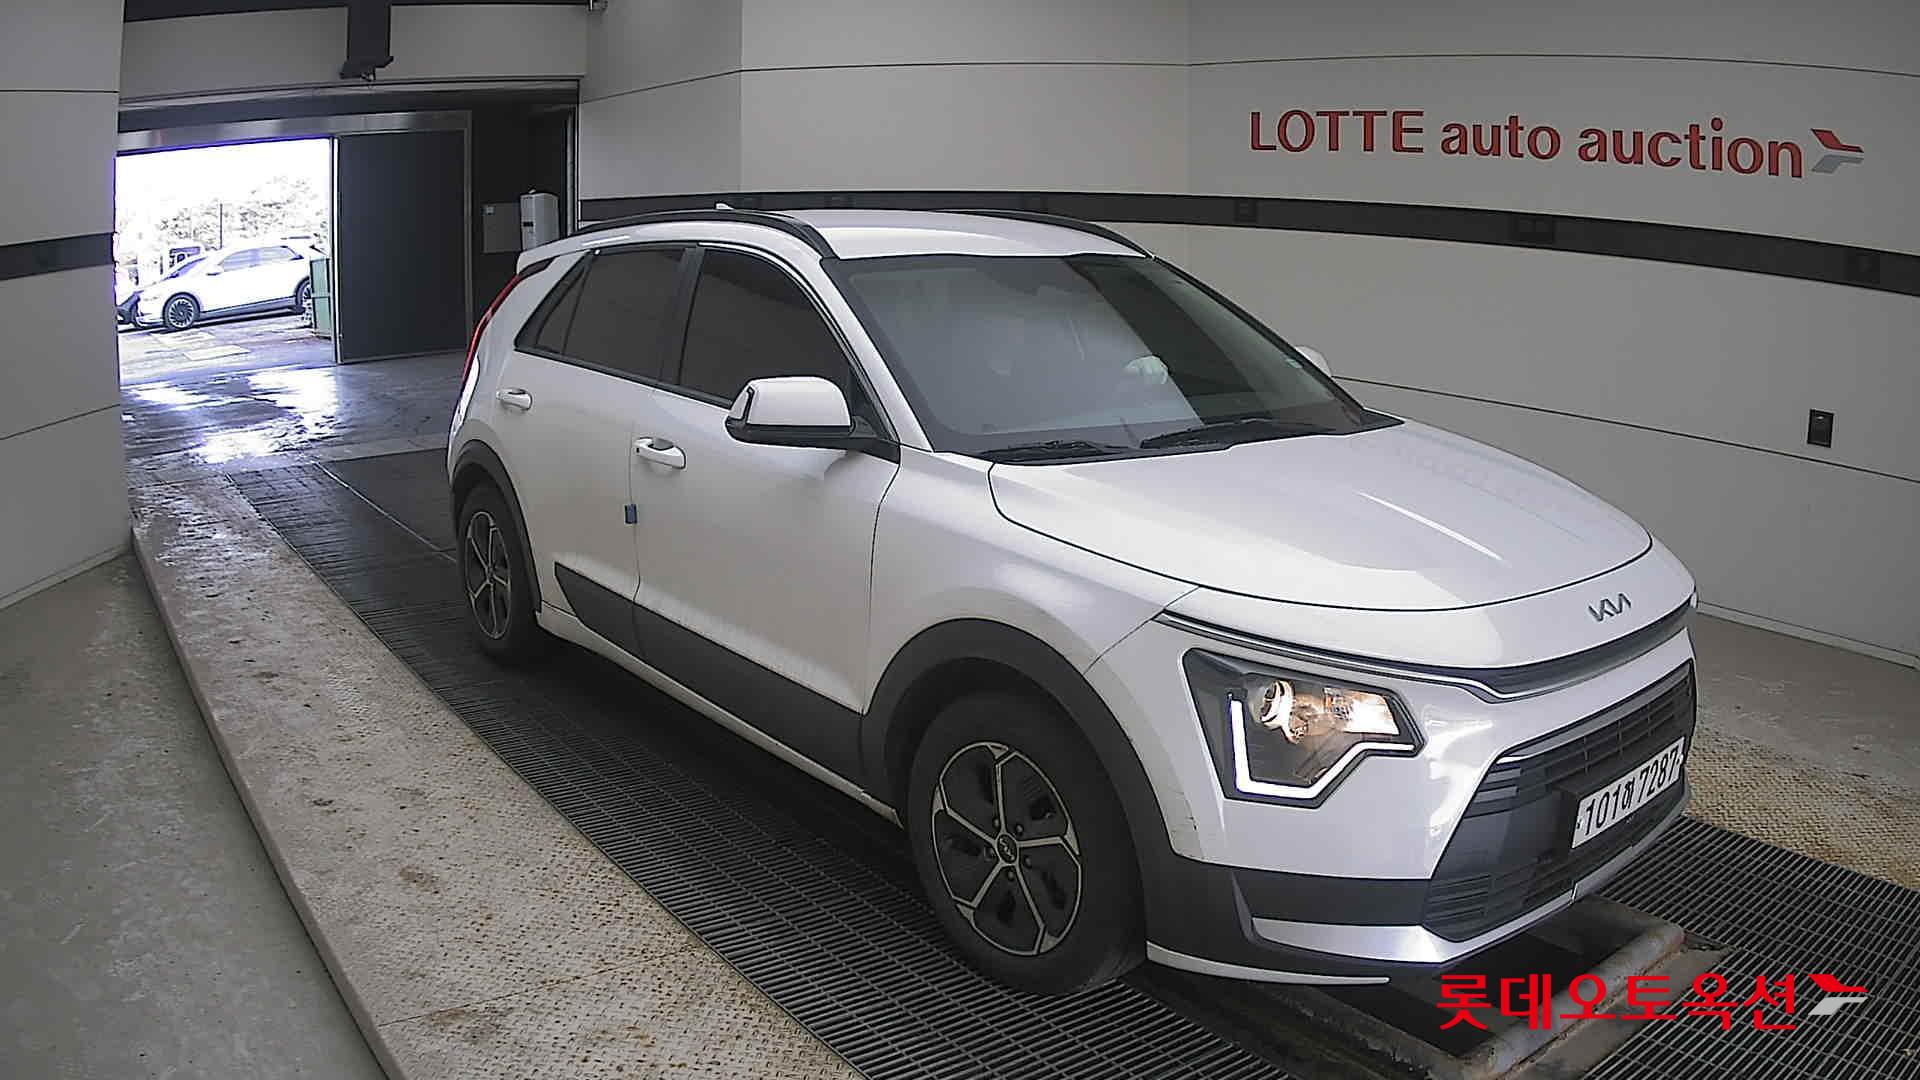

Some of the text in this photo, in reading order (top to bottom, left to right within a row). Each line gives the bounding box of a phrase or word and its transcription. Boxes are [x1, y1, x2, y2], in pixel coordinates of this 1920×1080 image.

[1251, 110, 1803, 178] LOTTE auto auction
[1638, 746, 1679, 803] 7287
